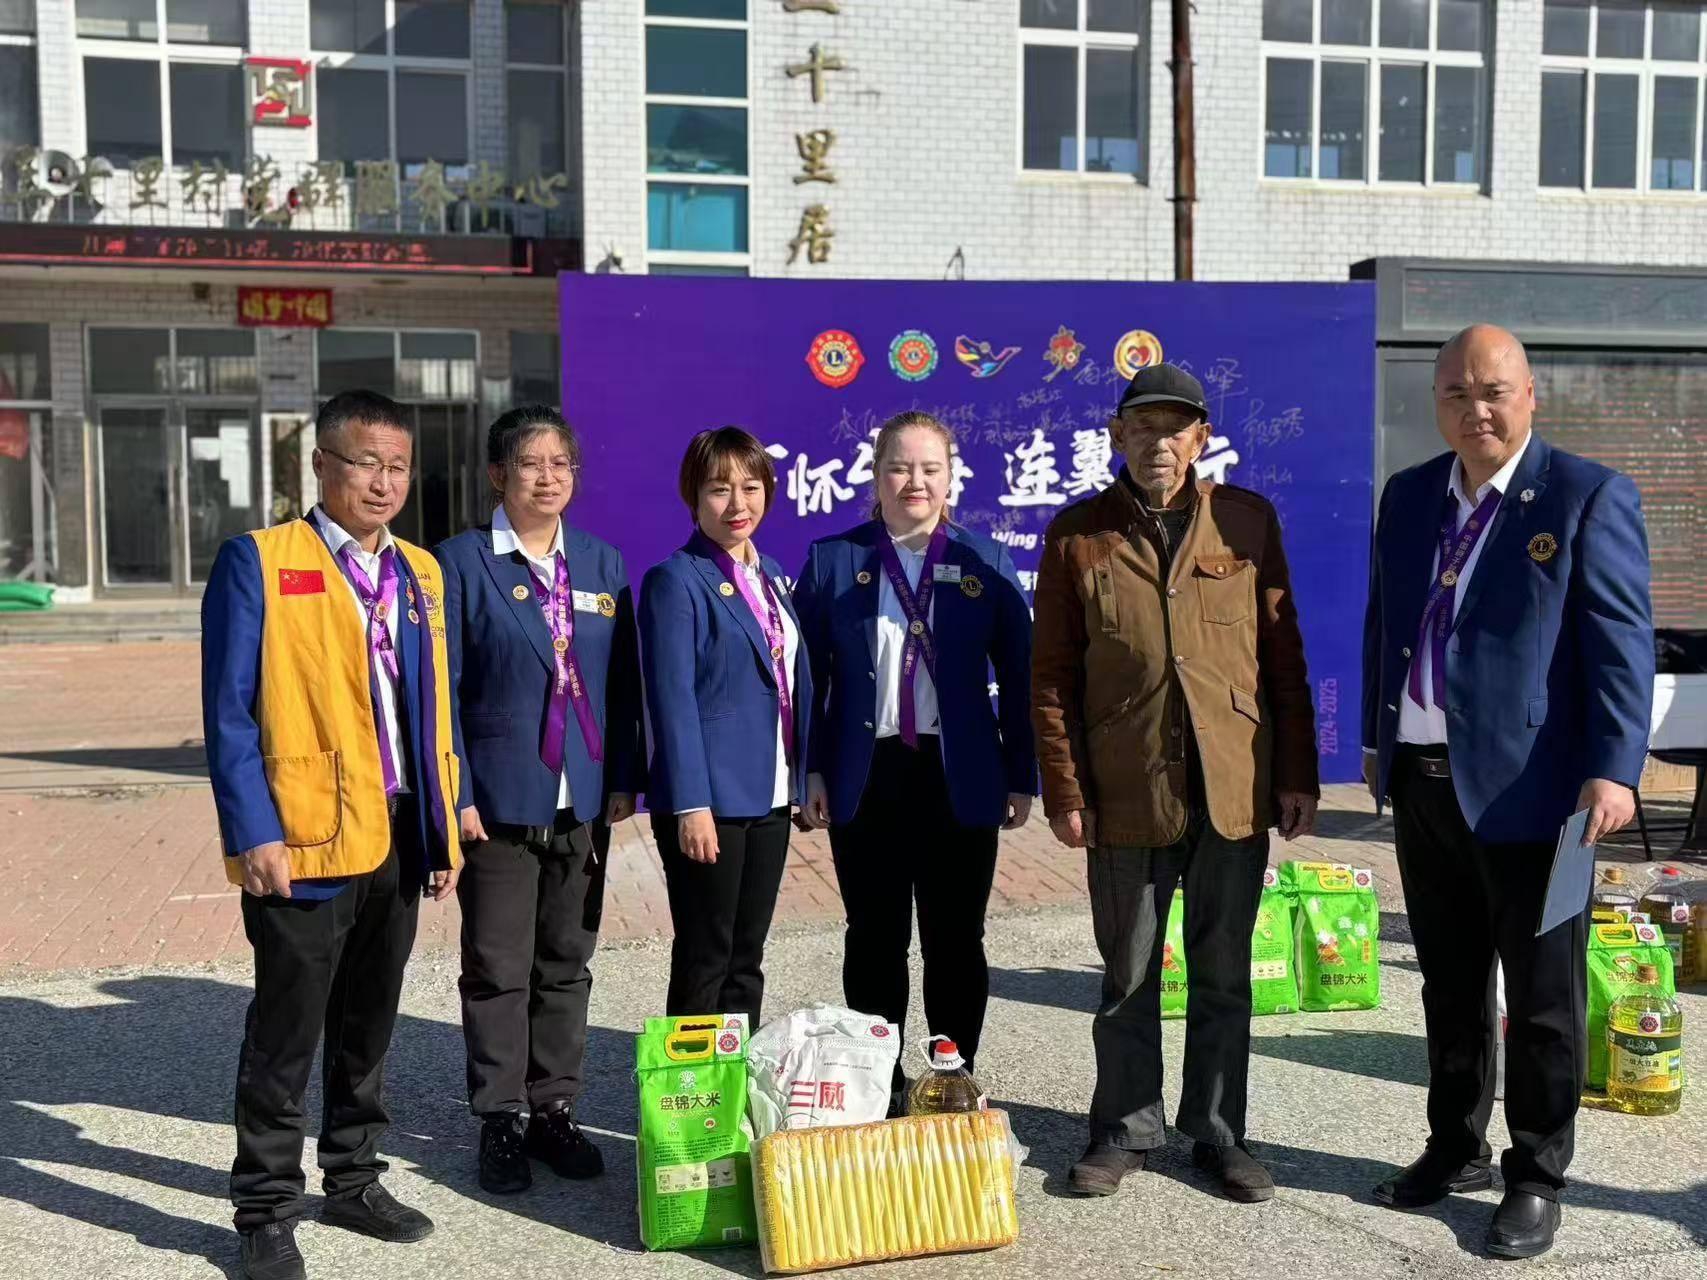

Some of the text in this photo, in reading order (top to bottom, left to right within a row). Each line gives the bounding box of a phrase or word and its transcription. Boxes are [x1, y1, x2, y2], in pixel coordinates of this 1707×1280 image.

[782, 0, 840, 266] 十里居
[1319, 678, 1338, 755] 2024-2025
[1320, 973, 1368, 986] 盘锦大米
[660, 1092, 721, 1111] 盘锦大米
[788, 1080, 846, 1112] 三威
